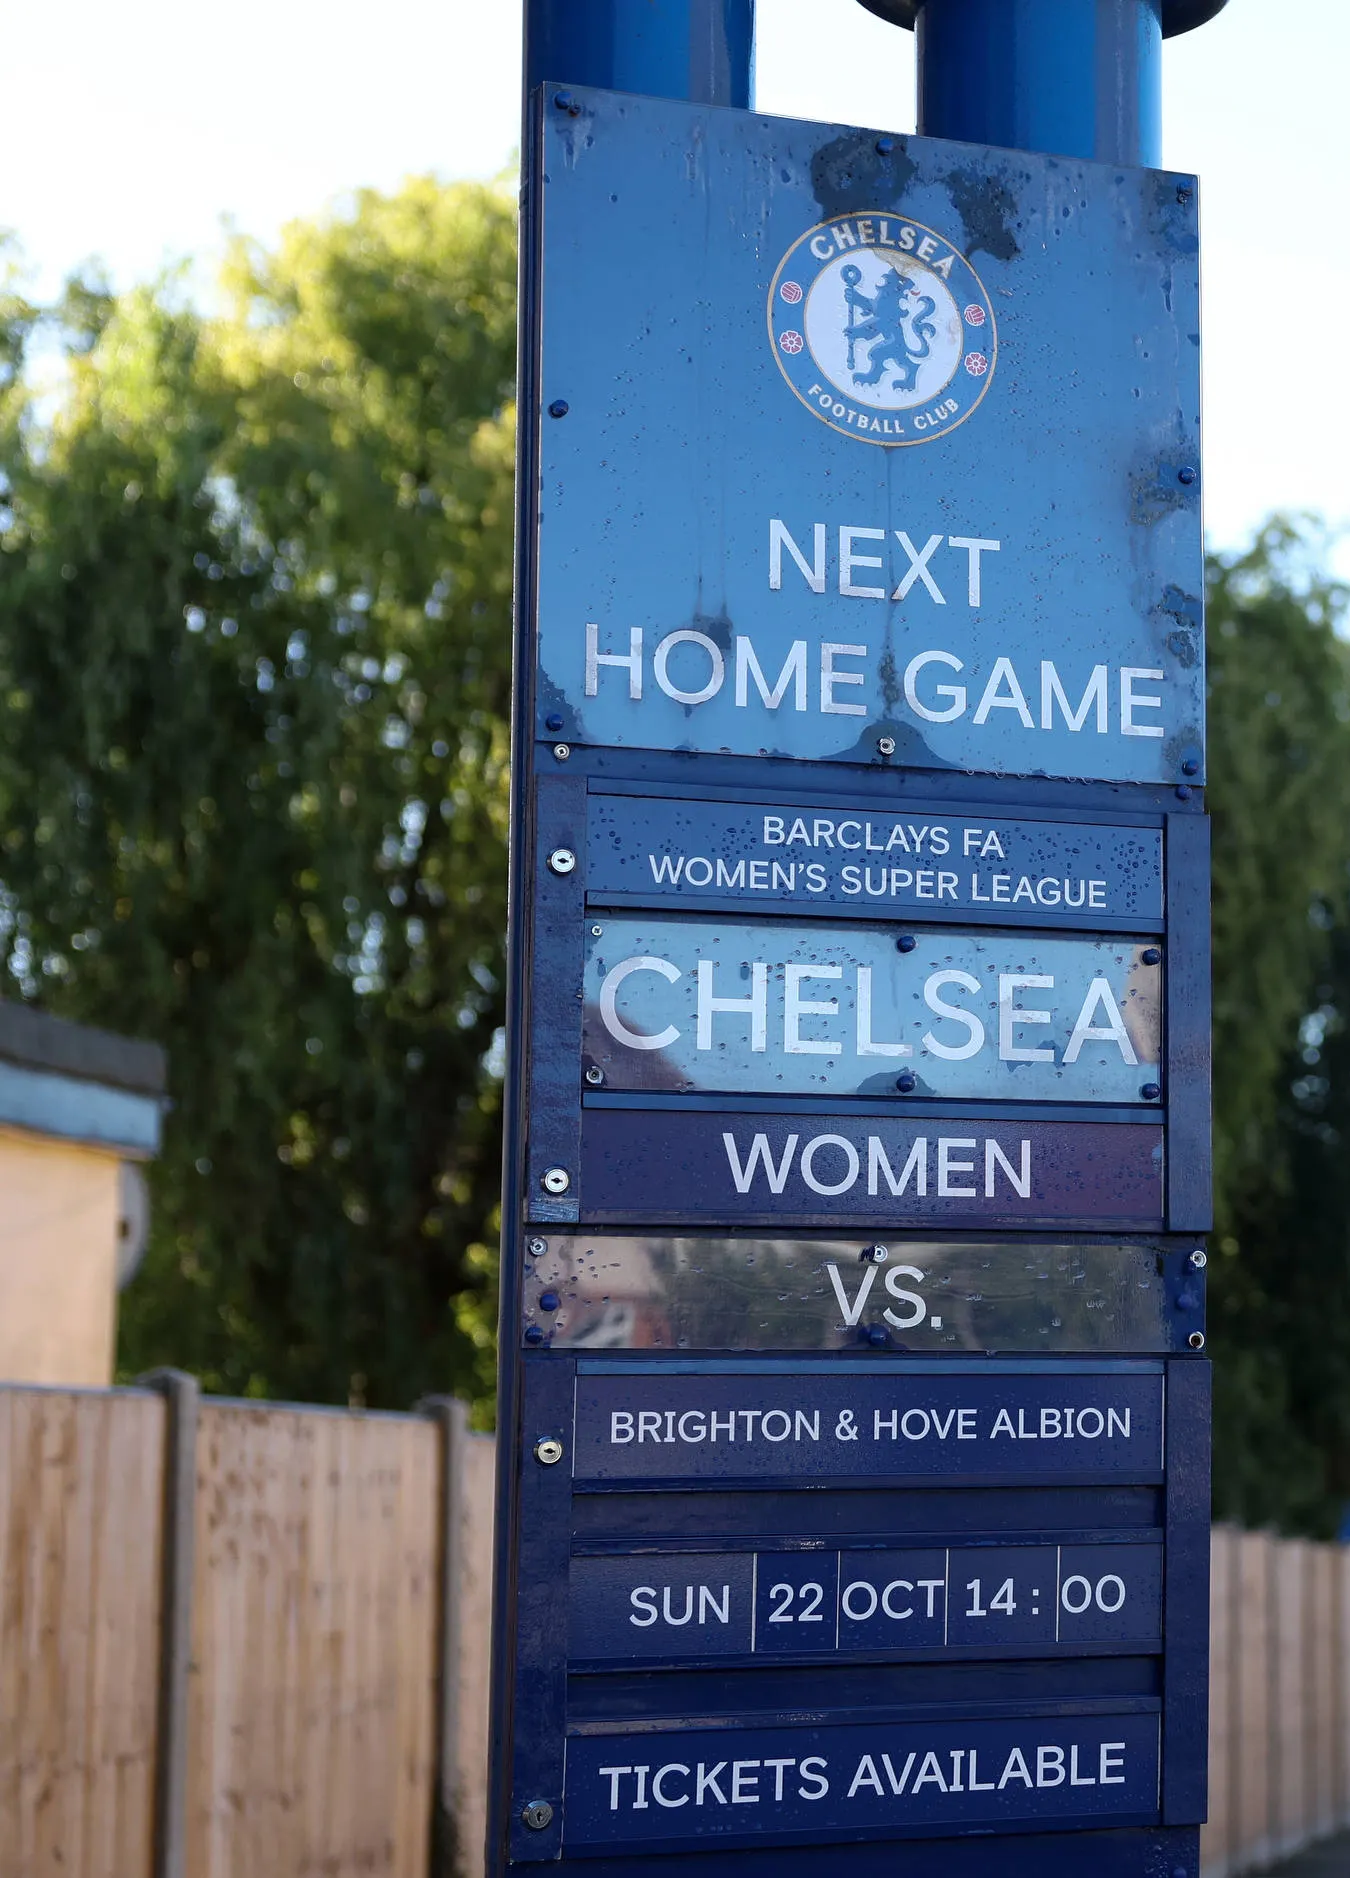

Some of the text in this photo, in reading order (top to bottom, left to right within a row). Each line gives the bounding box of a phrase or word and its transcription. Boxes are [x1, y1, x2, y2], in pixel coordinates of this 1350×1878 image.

[810, 220, 956, 279] CHELSEA
[808, 384, 961, 433] FOOTBALL CLUB
[768, 518, 1000, 608] NEXT
[584, 622, 1165, 738] HOME GAME
[762, 816, 1005, 859] BARCLAYS FA
[649, 854, 1107, 909] WOMEN'S SUPER LEAGUE
[600, 956, 1138, 1065] CHELSEA
[722, 1132, 1031, 1198] WOMEN
[826, 1263, 942, 1329] VS.
[609, 1407, 1133, 1444] BRIGHTON & HOVE ALBION
[628, 1585, 731, 1627] SUN
[768, 1583, 824, 1623] 22
[841, 1579, 945, 1620] OCT
[598, 1742, 1127, 1811] TICKETS AVAILABLE
